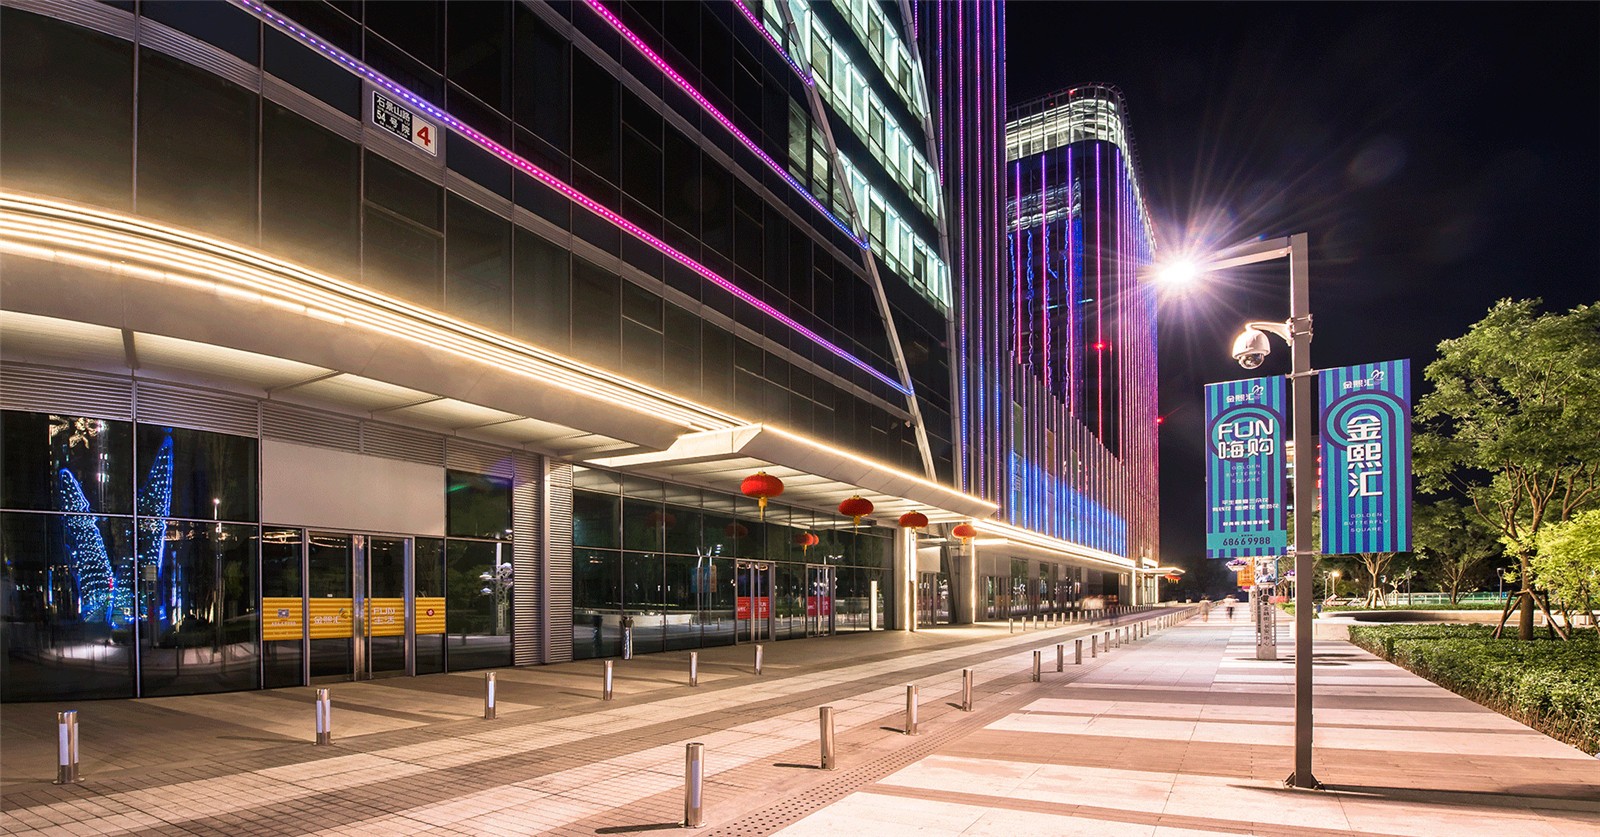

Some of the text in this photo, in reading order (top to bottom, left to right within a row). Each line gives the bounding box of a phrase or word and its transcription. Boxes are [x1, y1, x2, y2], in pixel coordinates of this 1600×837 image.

[376, 95, 411, 122] 石景山路
[416, 126, 431, 147] 4
[1218, 418, 1274, 440] FUN
[1218, 438, 1274, 460] 嗨购
[1346, 414, 1383, 498] 金熙汇
[1223, 537, 1271, 546] 68669988
